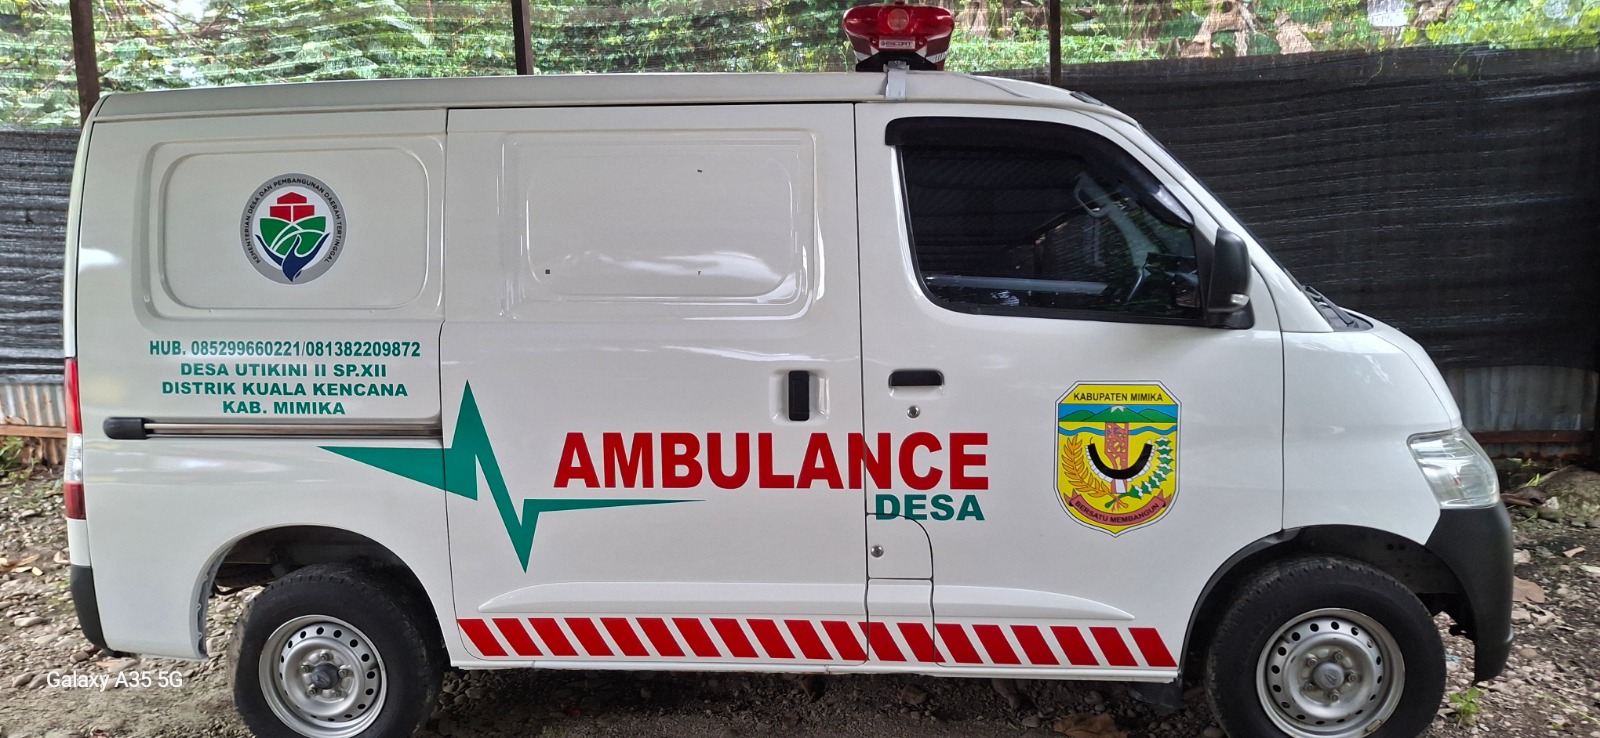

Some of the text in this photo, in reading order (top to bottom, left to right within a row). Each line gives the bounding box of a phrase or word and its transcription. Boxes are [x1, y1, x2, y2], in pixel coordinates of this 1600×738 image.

[244, 178, 342, 264] KEMENTERIAN DESA DAN PEMBANGUNAN DAERAH TERTINGGAL
[149, 340, 421, 357] HUB. 085299660221/081382209872
[180, 363, 387, 378] DESA UTIKINI II SP.XII
[162, 381, 408, 397] DISTRIK KUALA KENCANA
[1073, 392, 1164, 402] KABUPATEN MIMIKA
[222, 400, 346, 415] KAB. MIMIKA
[553, 431, 989, 490] AMBULANCE
[874, 494, 986, 521] DESA
[1074, 500, 1160, 524] BERSATU MEMBANGUN
